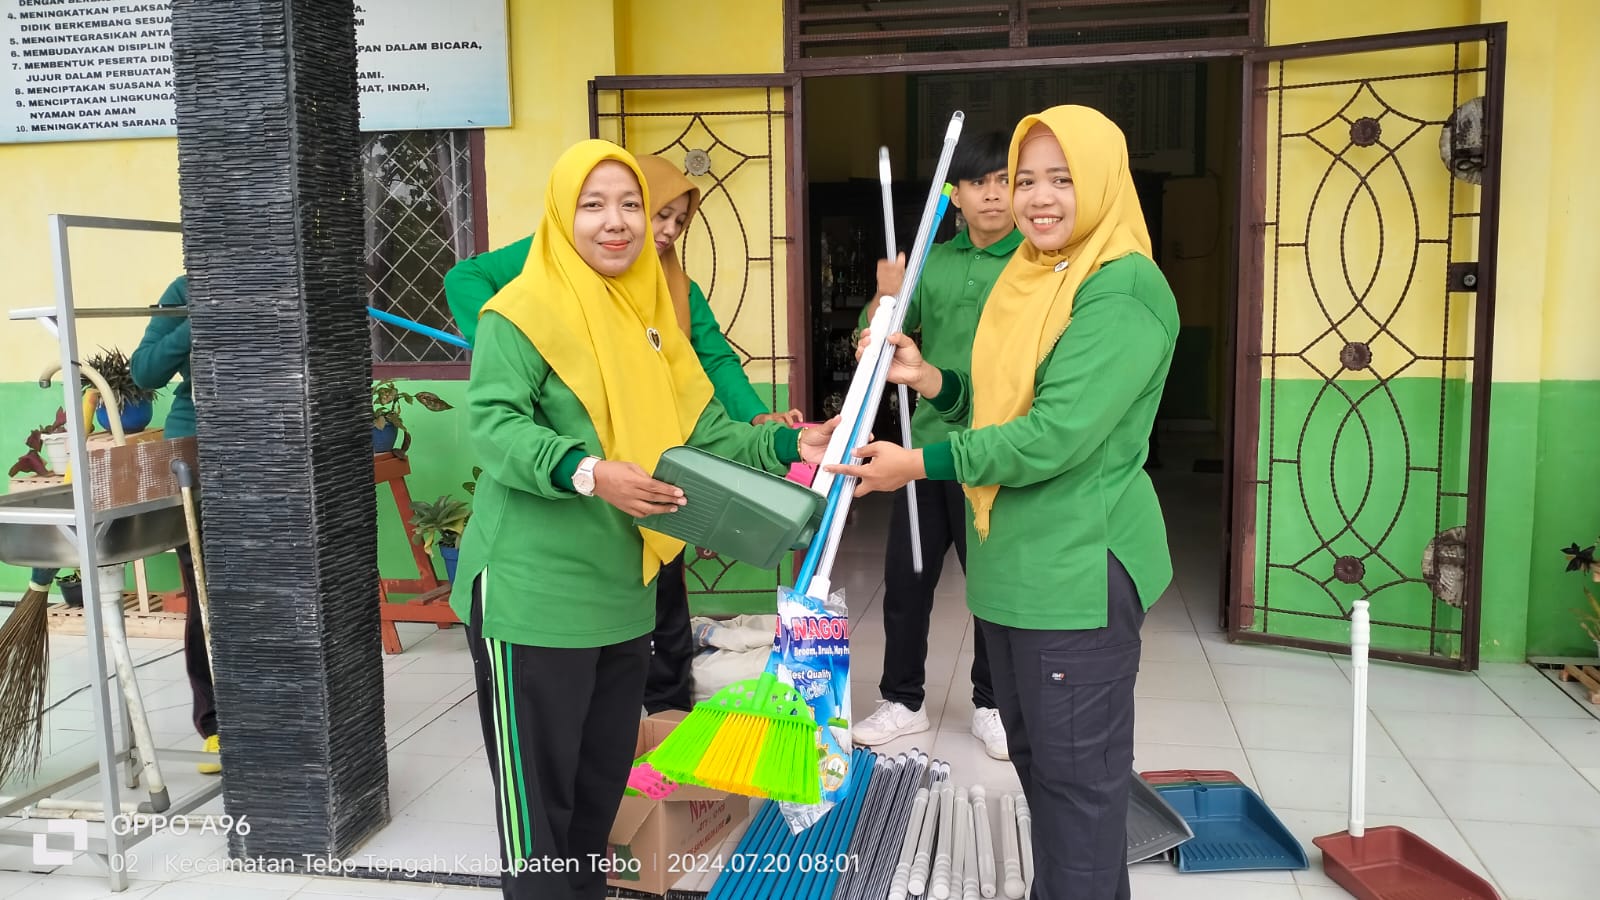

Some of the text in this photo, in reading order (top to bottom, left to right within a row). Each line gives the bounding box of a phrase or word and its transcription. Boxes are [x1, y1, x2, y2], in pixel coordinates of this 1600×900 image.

[20, 7, 109, 19] MENINGKATKAN
[112, 4, 172, 14] PELAKSAN
[20, 16, 172, 32] DIDIK BERKEMBANG SESUA
[9, 29, 170, 45] 5. MENGINTEGRASIKAN ANTA
[10, 50, 20, 58] 6.
[23, 45, 115, 57] MEMBUDAYAKAN
[118, 42, 166, 52] DISIPLIN
[12, 41, 482, 71] 7. MEMBENTUK PESERTA DIDI PAN DALAM BICARA,
[26, 67, 171, 82] JUJUR DALAM PERBUATAN
[15, 87, 24, 95] 8.
[27, 83, 106, 95] MENCIPTAKAN
[109, 80, 161, 90] SUASANA
[359, 71, 385, 79] AMI.
[16, 83, 430, 108] 9. MENCIPTAKAN LINGKUNGA HAT, INDAH,
[30, 107, 136, 119] NYAMAN DAN AMAN
[16, 125, 29, 133] 10.
[31, 120, 119, 132] MENINGKATKAN
[122, 118, 167, 127] SARANA
[790, 616, 849, 641] NAGOY
[806, 669, 832, 681] Quality
